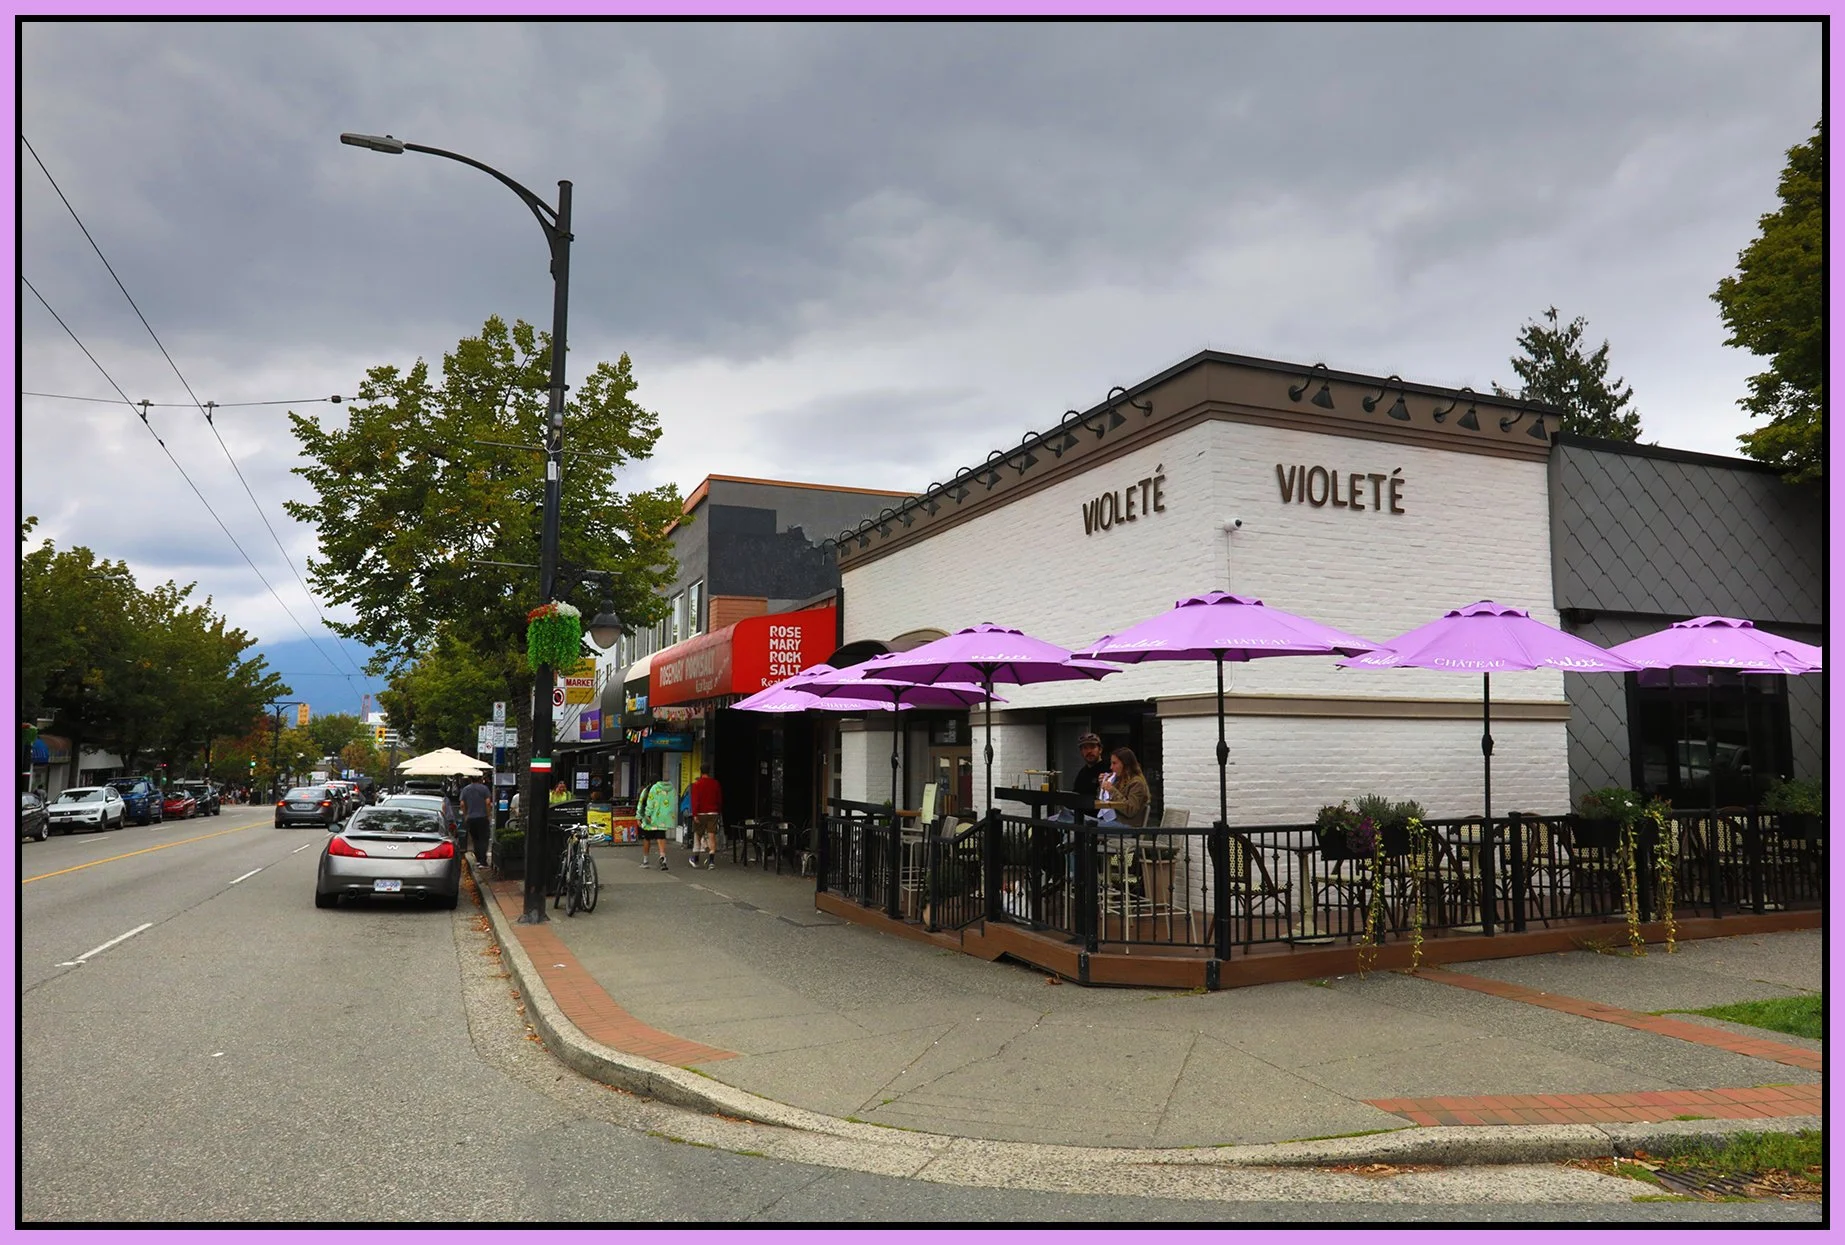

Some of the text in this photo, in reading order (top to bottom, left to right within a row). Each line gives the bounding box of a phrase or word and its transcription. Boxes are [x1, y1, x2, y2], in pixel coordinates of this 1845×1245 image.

[1276, 463, 1405, 514] VIOLETÉ
[1082, 463, 1166, 535] VIOLETÉ
[769, 625, 802, 638] ROSE
[769, 638, 802, 651] MARY
[769, 651, 802, 664] ROCK
[769, 664, 802, 676] SALT
[565, 678, 595, 687] MARKET
